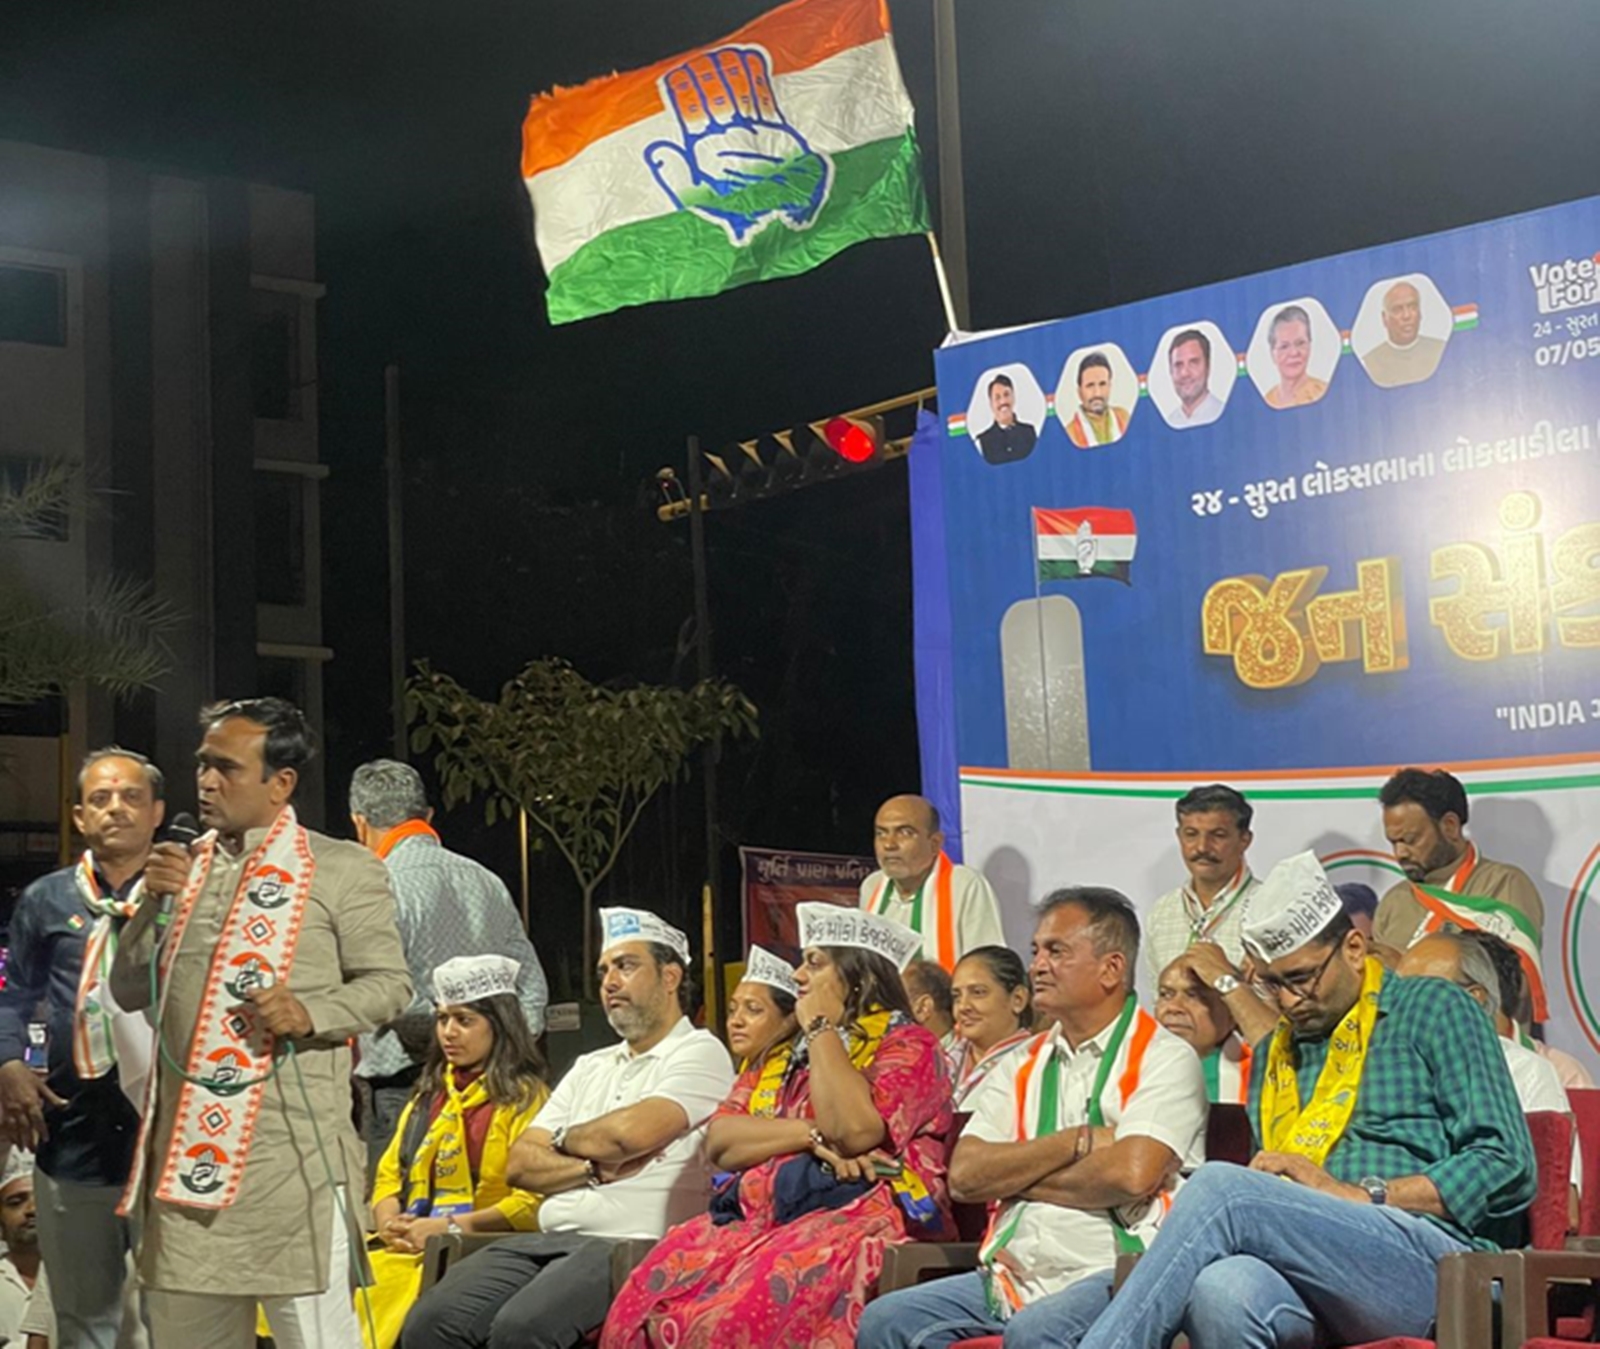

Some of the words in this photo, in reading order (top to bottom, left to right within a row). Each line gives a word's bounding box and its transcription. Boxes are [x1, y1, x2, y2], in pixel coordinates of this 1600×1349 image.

[1529, 259, 1593, 287] Vote
[1550, 280, 1597, 307] For
[1244, 477, 1297, 518] સુરત
[1302, 454, 1435, 498] લોકસભાના
[1442, 420, 1590, 473] લોકલાડીલા
[1202, 557, 1409, 688] જન
